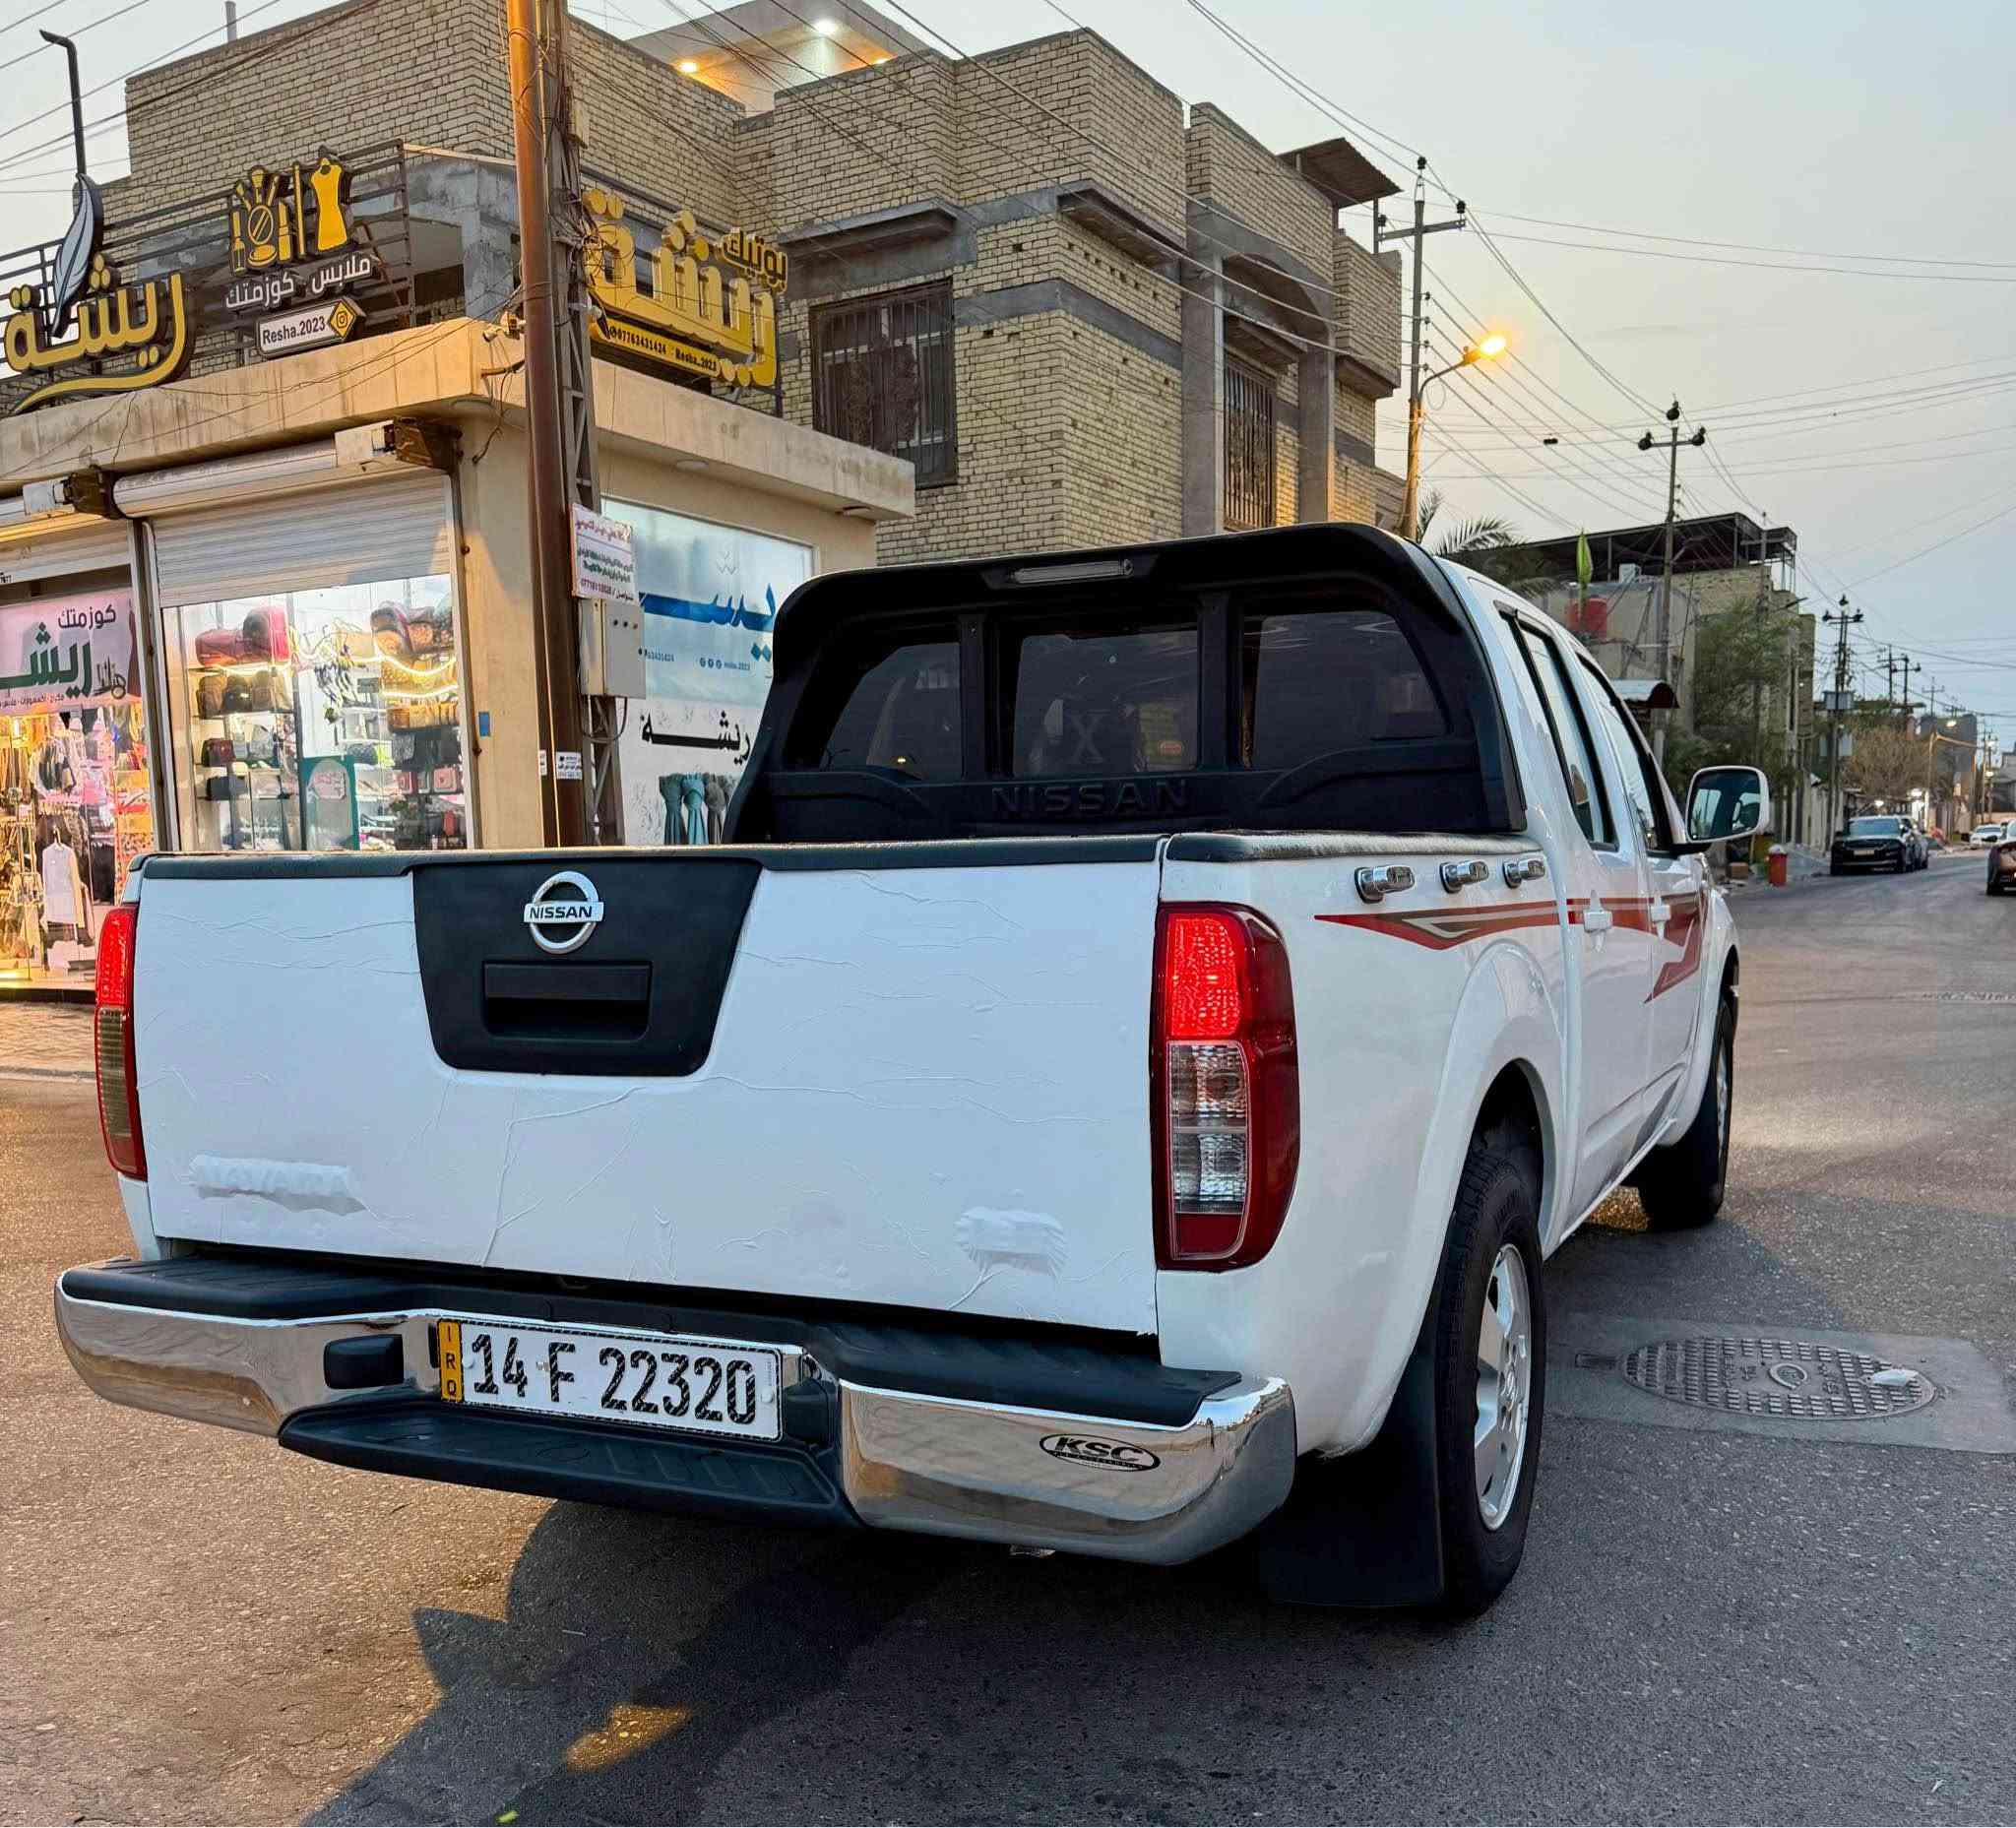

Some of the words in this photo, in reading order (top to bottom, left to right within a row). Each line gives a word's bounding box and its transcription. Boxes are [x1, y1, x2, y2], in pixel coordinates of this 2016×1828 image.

[311, 253, 371, 293] ملابس
[723, 231, 787, 291] بوتيك
[225, 271, 294, 309] كوزمتك
[4, 252, 188, 413] ريشة
[262, 315, 326, 345] Resha.2023
[58, 604, 116, 630] كوزمتك
[0, 622, 93, 698] ريش
[992, 779, 1187, 819] NISSAN
[530, 906, 593, 918] NISSAN
[446, 1325, 458, 1396] IRQ
[472, 1333, 528, 1397] 14
[548, 1341, 576, 1402] F
[598, 1346, 756, 1424] 22320
[1054, 1436, 1144, 1462] KSC
